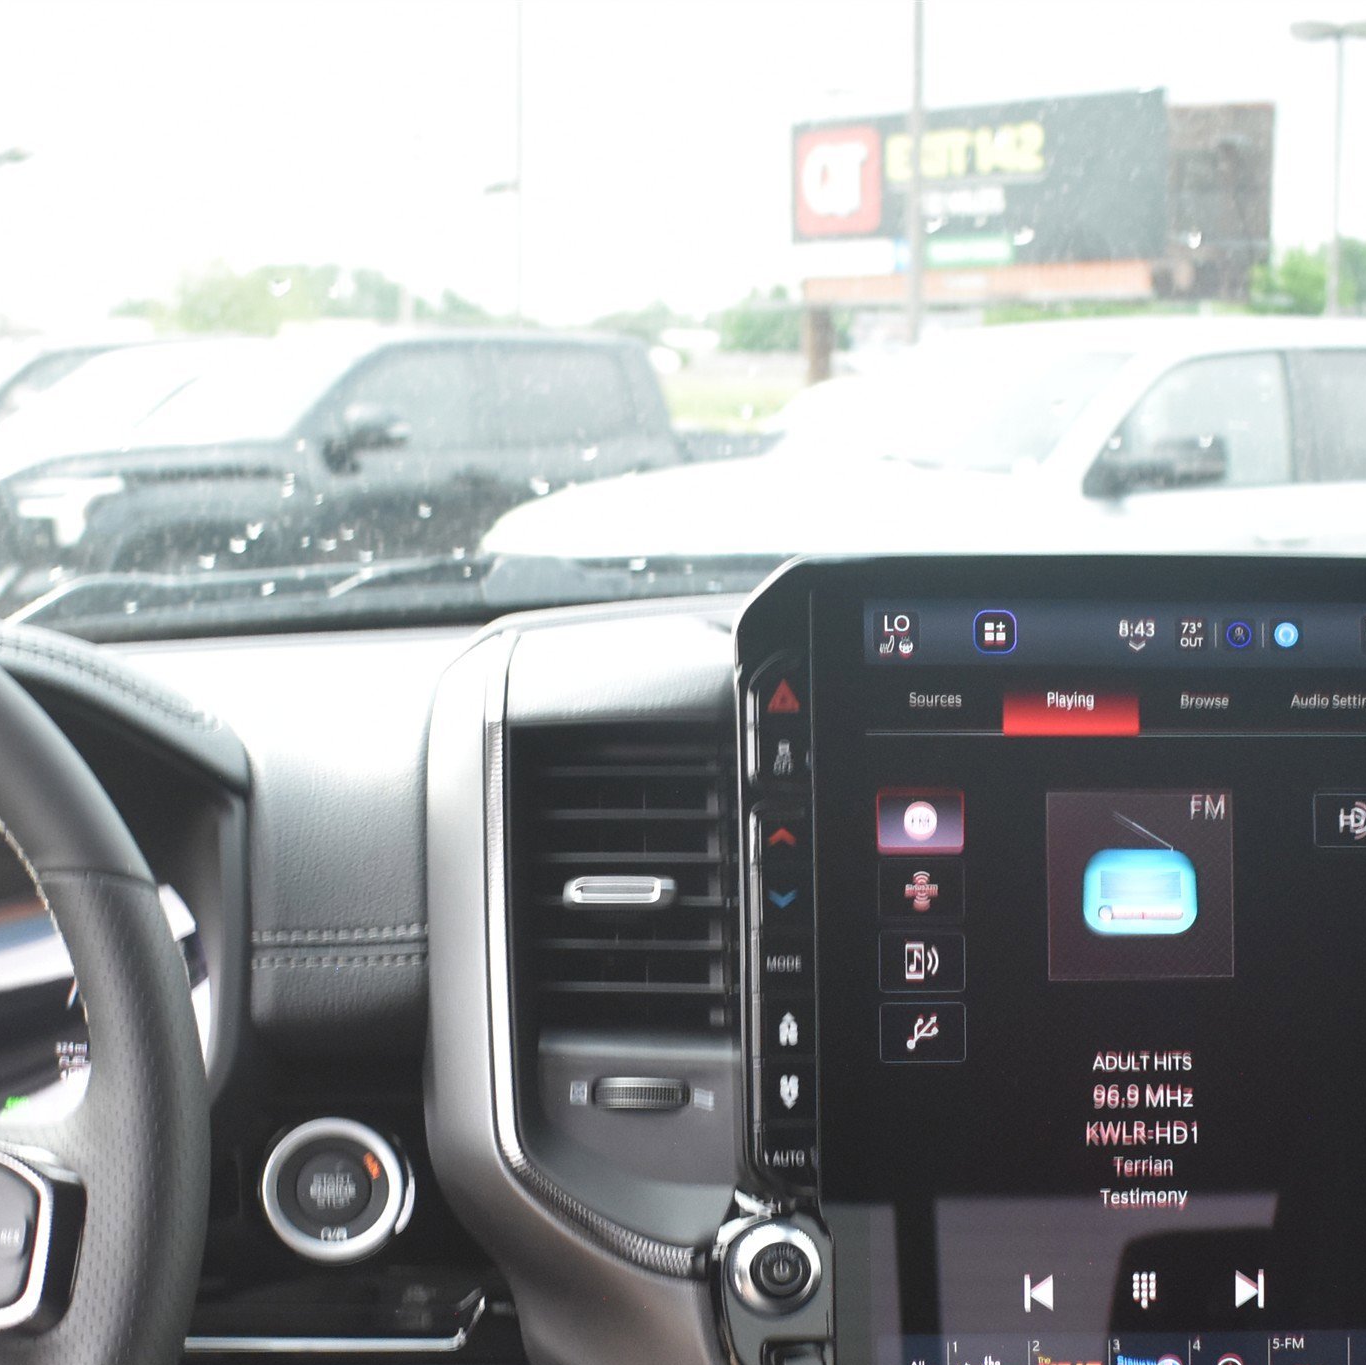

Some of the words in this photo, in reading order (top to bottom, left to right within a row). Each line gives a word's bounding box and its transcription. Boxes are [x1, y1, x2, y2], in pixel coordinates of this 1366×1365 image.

[883, 614, 911, 633] LO
[1118, 618, 1156, 639] 8:43
[1180, 636, 1204, 648] OUT
[908, 691, 963, 708] Sources
[1046, 691, 1095, 712] Playing
[1179, 692, 1230, 710] Browse
[1290, 693, 1330, 710] Audio
[1189, 794, 1227, 821] FM
[766, 955, 803, 973] MODE
[1092, 1051, 1150, 1072] ADULT
[1153, 1050, 1193, 1072] HITS
[1093, 1083, 1140, 1110] 96.9
[1145, 1083, 1194, 1109] MHz
[1085, 1120, 1199, 1147] KWLR-HD1
[1114, 1155, 1175, 1178] Terrian
[1099, 1187, 1188, 1210] Testimony
[1032, 1340, 1041, 1352] 2
[1112, 1338, 1121, 1352] 3
[1192, 1337, 1202, 1351] 4
[1271, 1336, 1305, 1350] 5-FM
